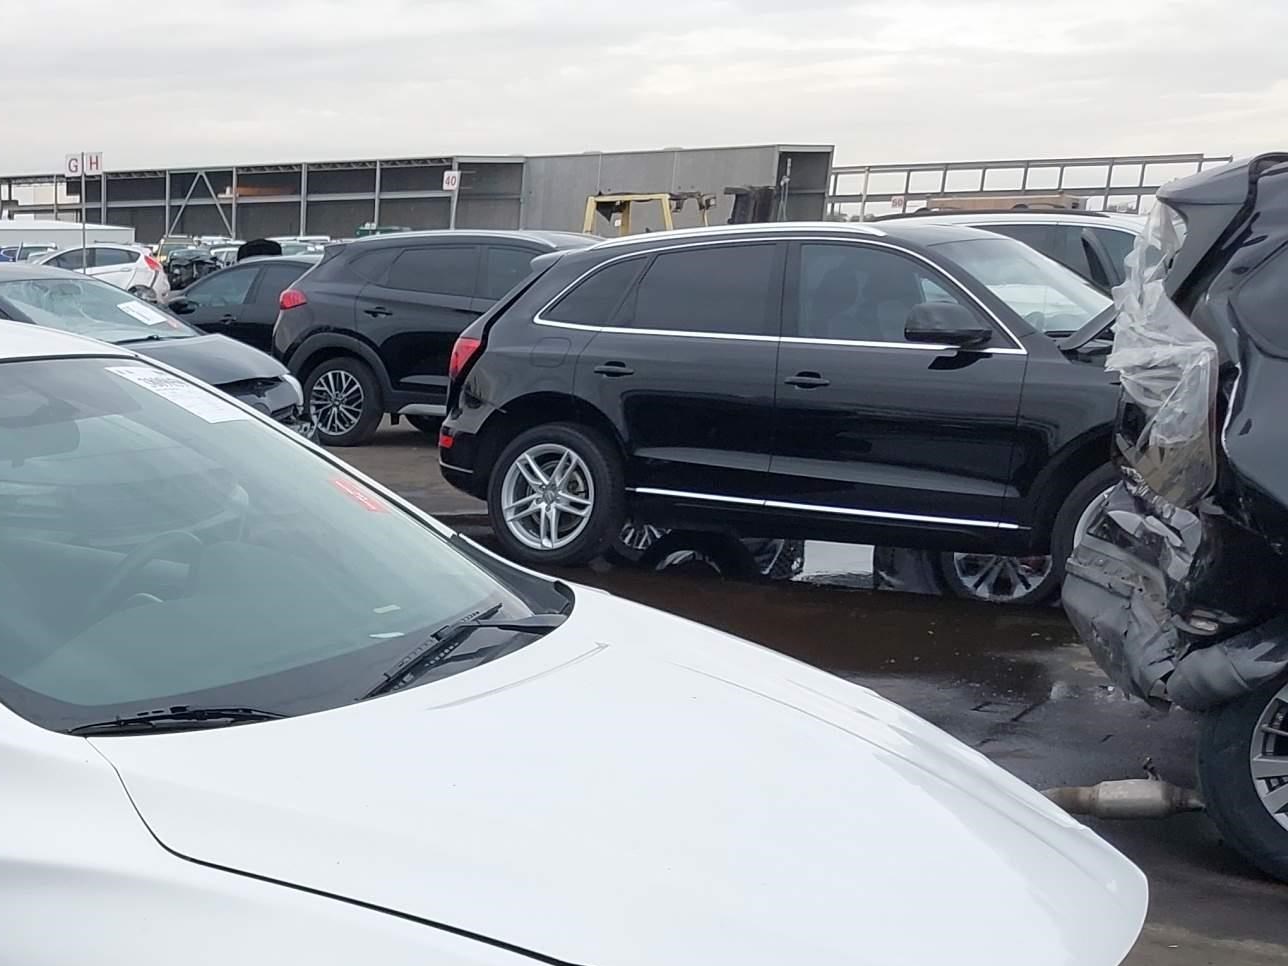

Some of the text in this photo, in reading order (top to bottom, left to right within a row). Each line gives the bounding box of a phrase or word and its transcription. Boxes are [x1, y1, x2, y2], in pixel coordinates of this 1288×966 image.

[68, 158, 79, 173] G
[89, 155, 99, 171] H
[445, 175, 457, 186] 40
